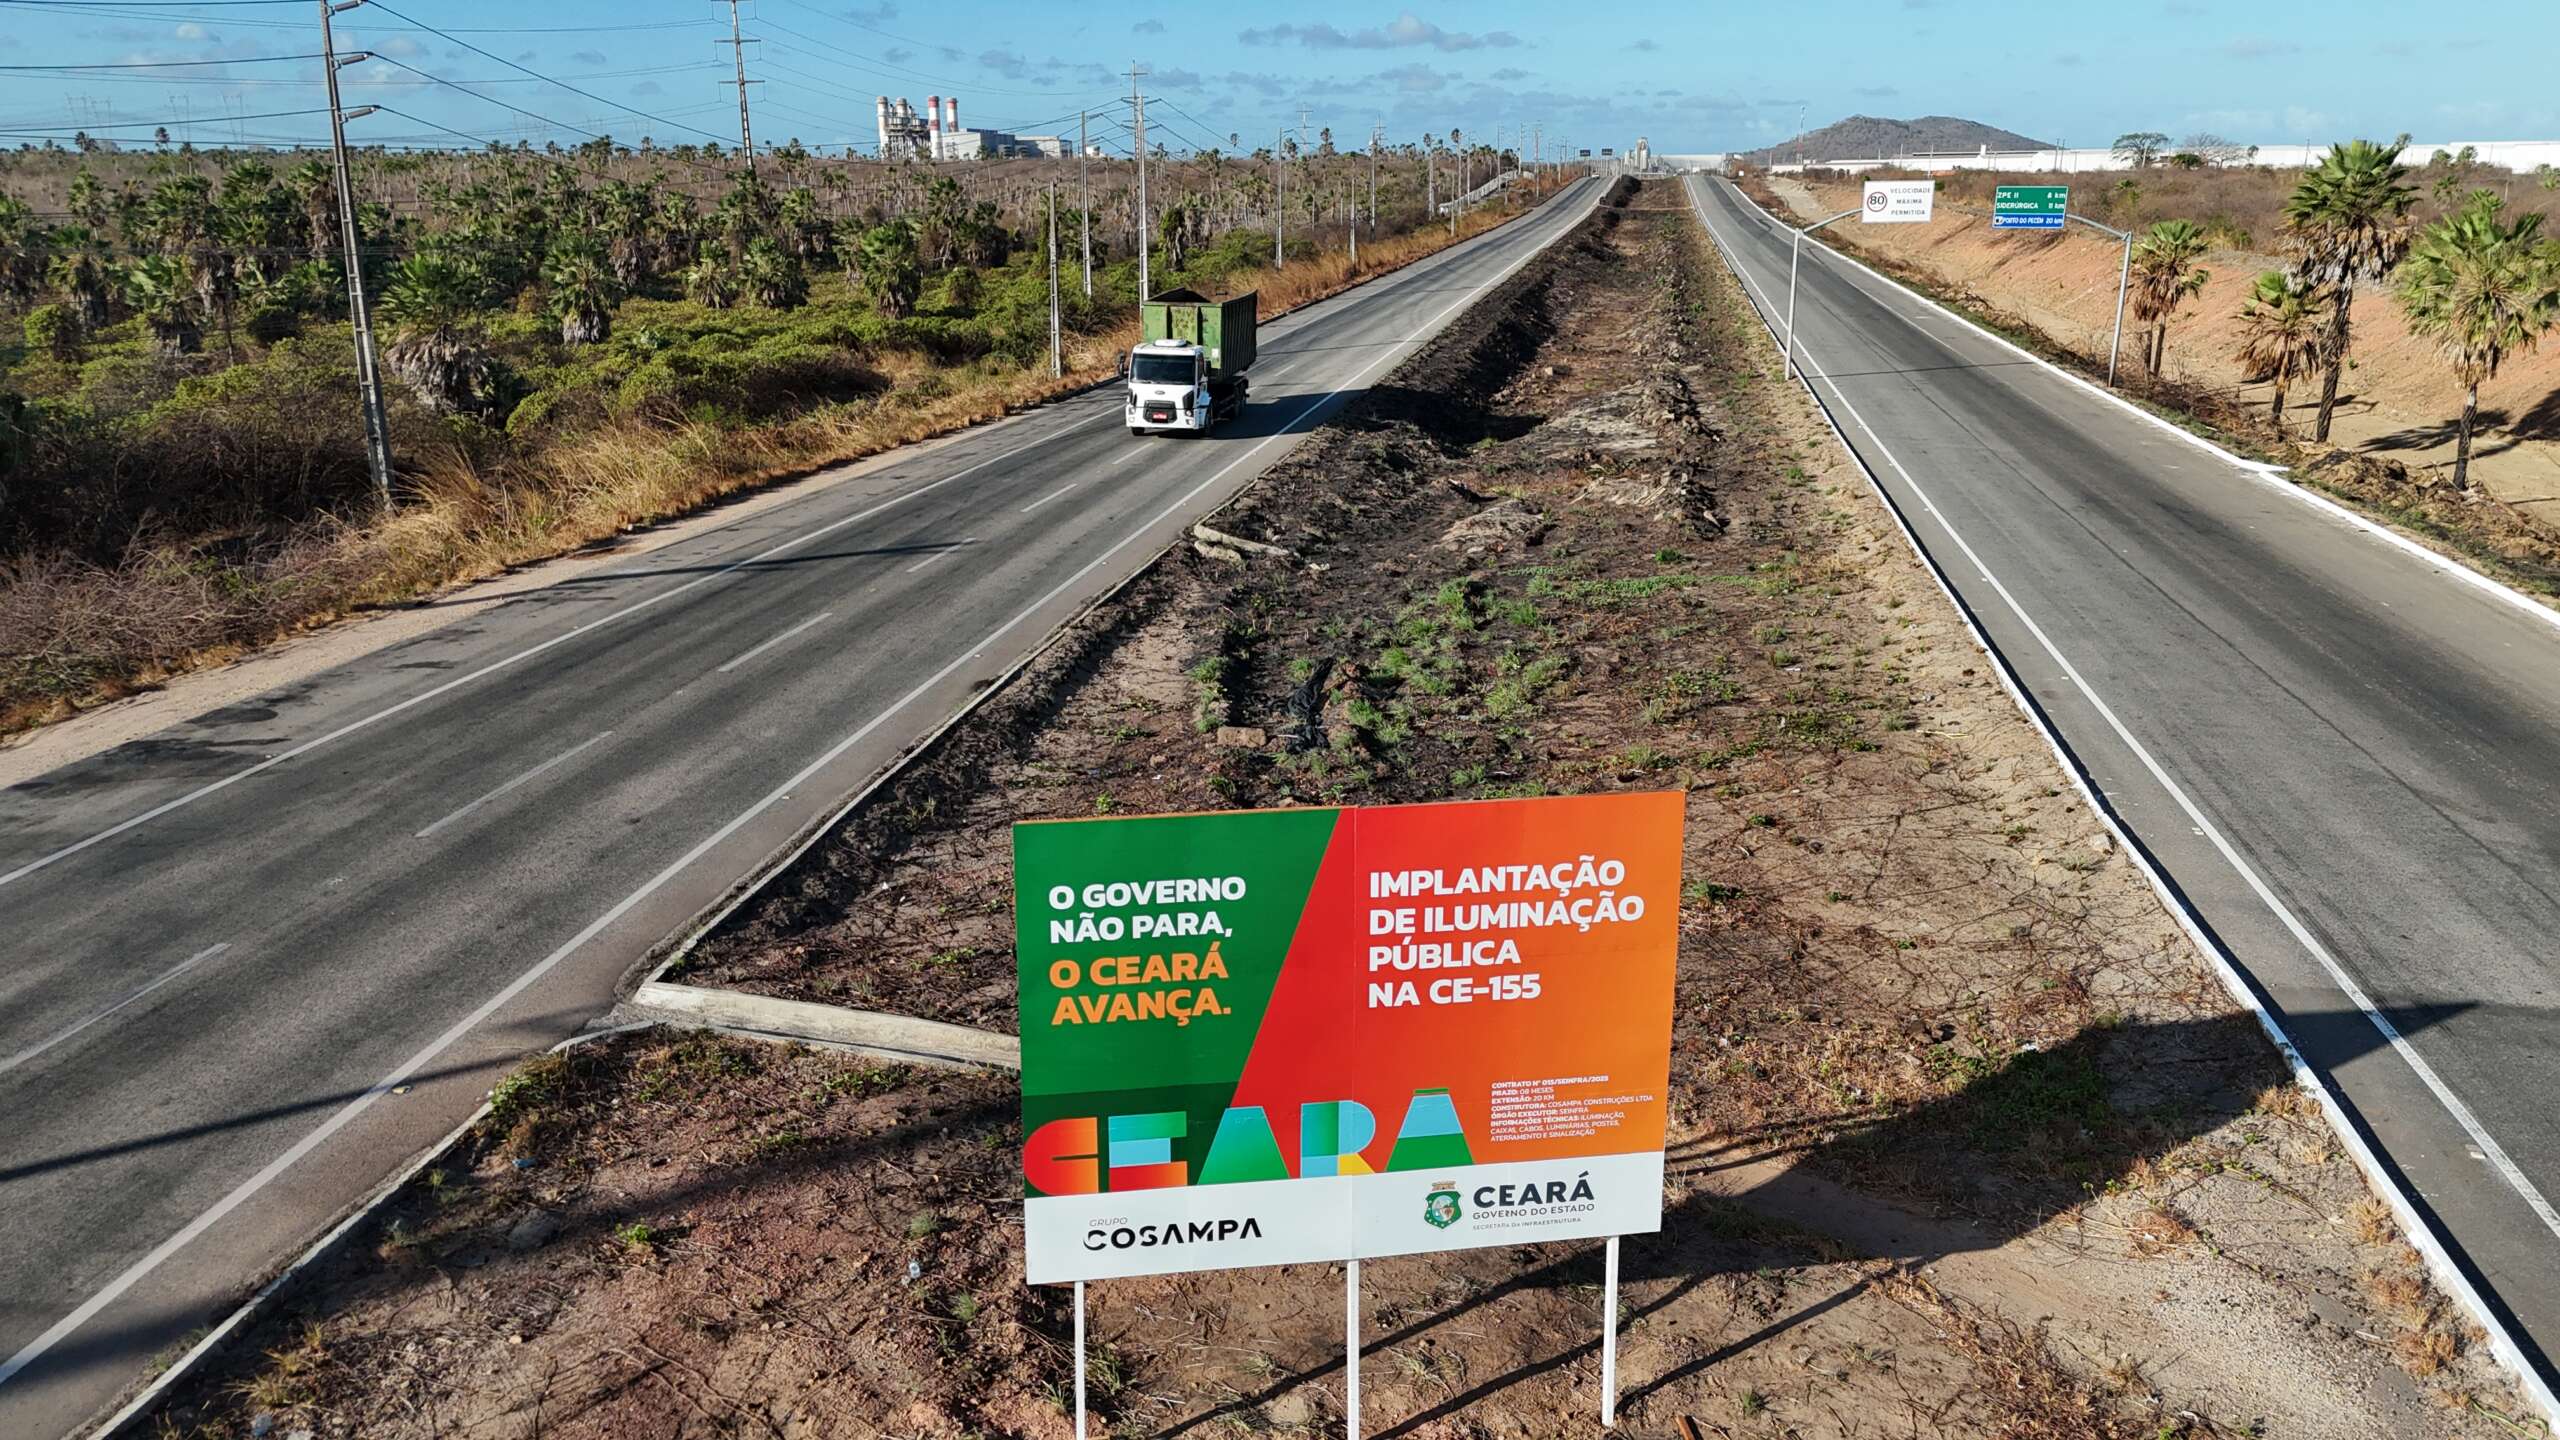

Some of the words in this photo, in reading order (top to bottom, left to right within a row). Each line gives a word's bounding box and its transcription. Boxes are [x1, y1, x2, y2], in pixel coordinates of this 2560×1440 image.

[1870, 196, 1885, 205] 80
[1369, 855, 1626, 898] IMPLANTAÇÃO
[1049, 886, 1075, 910] O
[1082, 876, 1247, 908] GOVERNO
[1369, 907, 1416, 936] DE
[1423, 890, 1645, 933] ILUMINAÇÃO
[1050, 912, 1125, 944] NÃO
[1132, 911, 1233, 939] PARA,
[1049, 959, 1081, 989] O
[1089, 941, 1230, 986] CEARÁ
[1368, 936, 1522, 972] PÚBLICA
[1368, 981, 1421, 1008] NA
[1429, 973, 1542, 1005] CE-155
[1051, 987, 1232, 1027] AVANÇA.
[1492, 1081, 1532, 1089] CONTRATO
[1491, 1095, 1532, 1105] EXTENSÃO:
[1491, 1102, 1546, 1112] CONSTRUTORA:
[1583, 1095, 1634, 1106] CONSTRUÇÕES
[1490, 1118, 1542, 1127] INFORMAÇÕES
[1543, 1115, 1579, 1123] TÉCNICAS:
[1491, 1110, 1517, 1119] ÓRGÃO
[1518, 1109, 1557, 1117] EXECUTOR:
[1549, 1128, 1596, 1137] SINALIZAÇÃO
[1473, 1170, 1595, 1208] CEARÁ
[1089, 1217, 1128, 1227] GRUPO
[1473, 1209, 1528, 1220] GOVERNO
[1530, 1208, 1548, 1216] DO
[1551, 1203, 1595, 1214] ESTADO
[1522, 1217, 1582, 1227] INFRAESTRUTURA
[1083, 1218, 1262, 1251] COSAMPA
